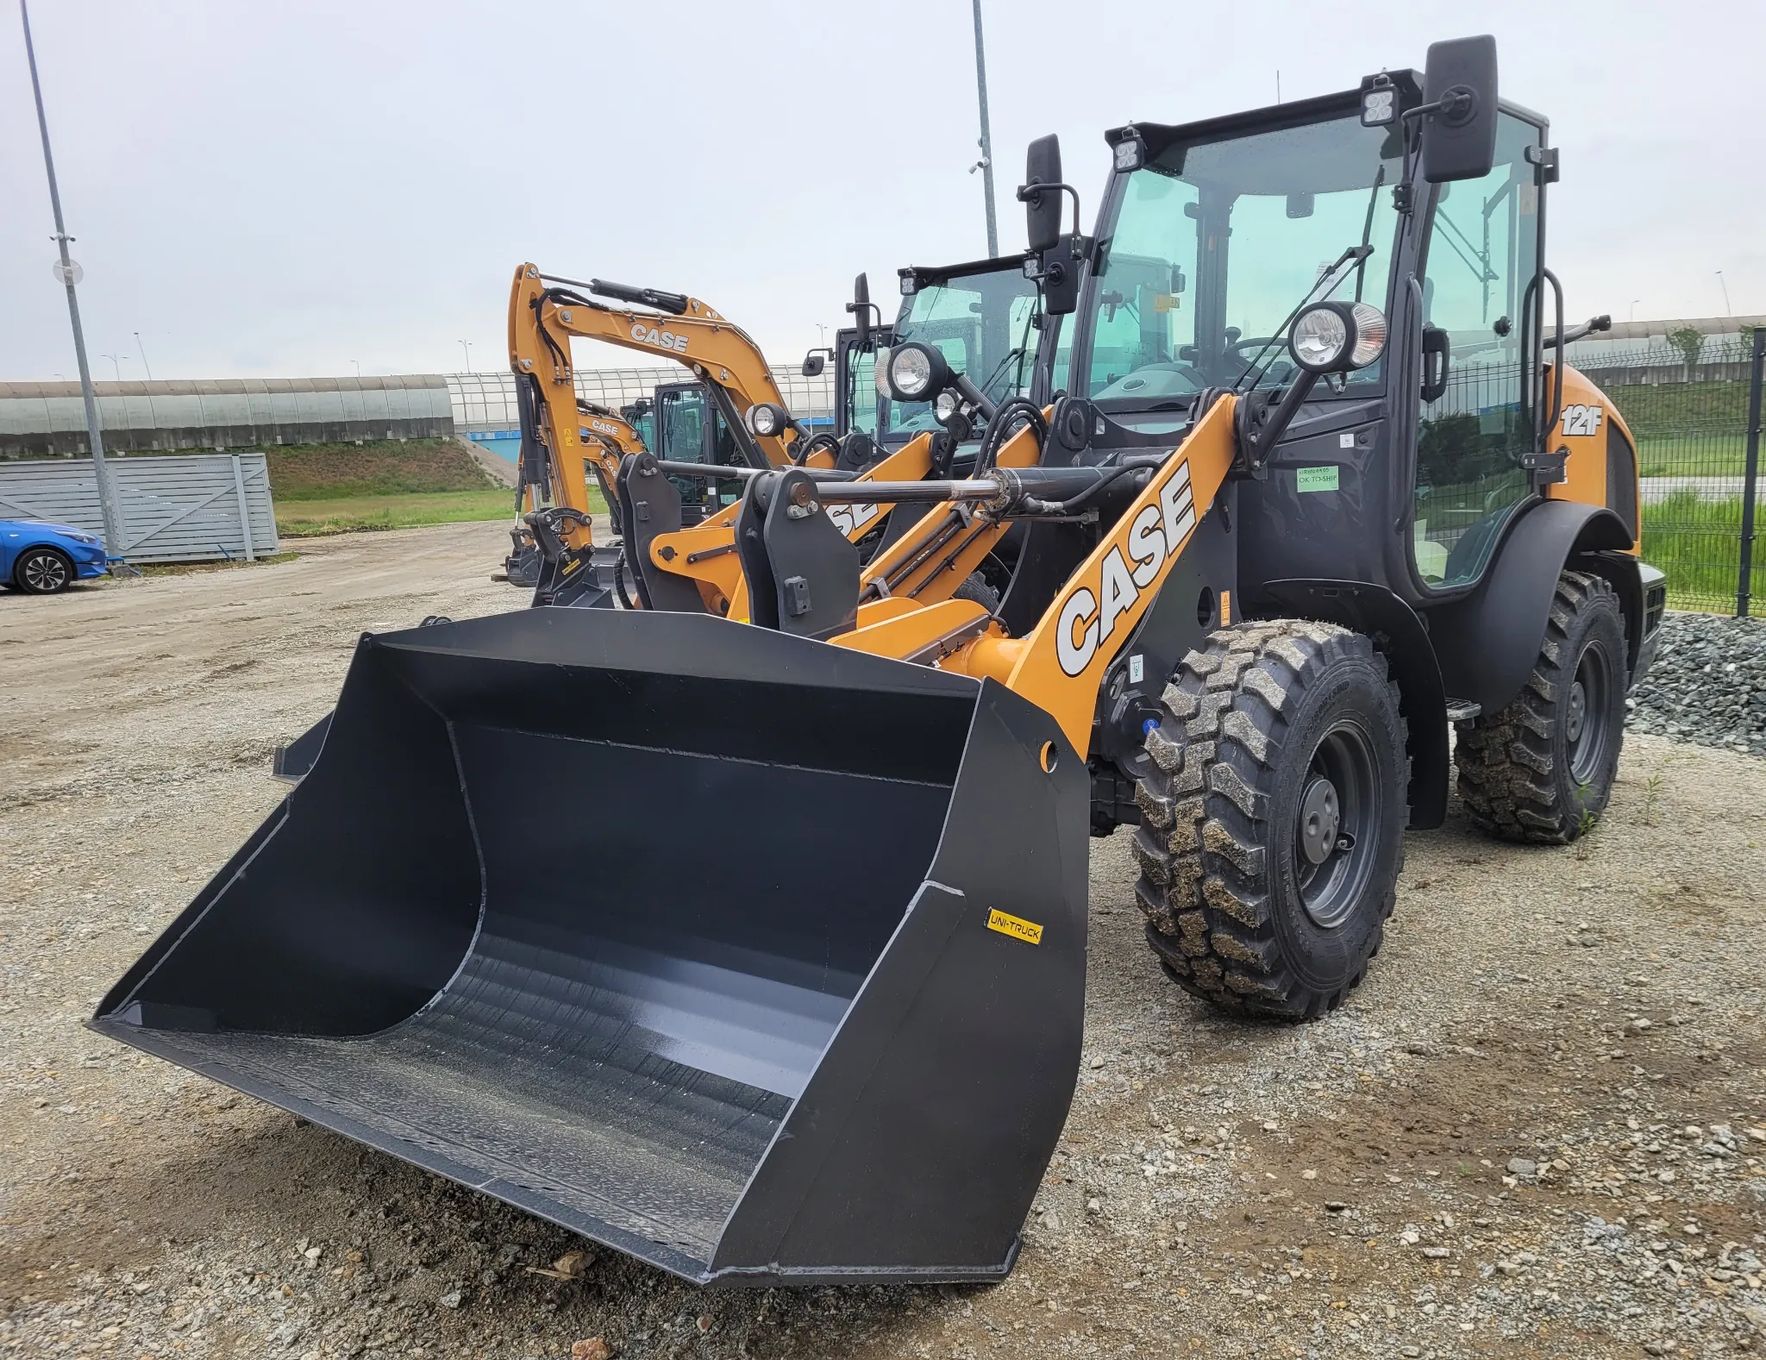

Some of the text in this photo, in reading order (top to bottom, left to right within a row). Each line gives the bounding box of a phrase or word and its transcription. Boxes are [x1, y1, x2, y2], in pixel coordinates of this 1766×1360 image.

[630, 323, 689, 353] CASE
[592, 419, 618, 435] CASE
[1560, 404, 1603, 436] 121F
[1056, 457, 1197, 677] CASE
[990, 915, 1041, 939] UNI-TRUCK
